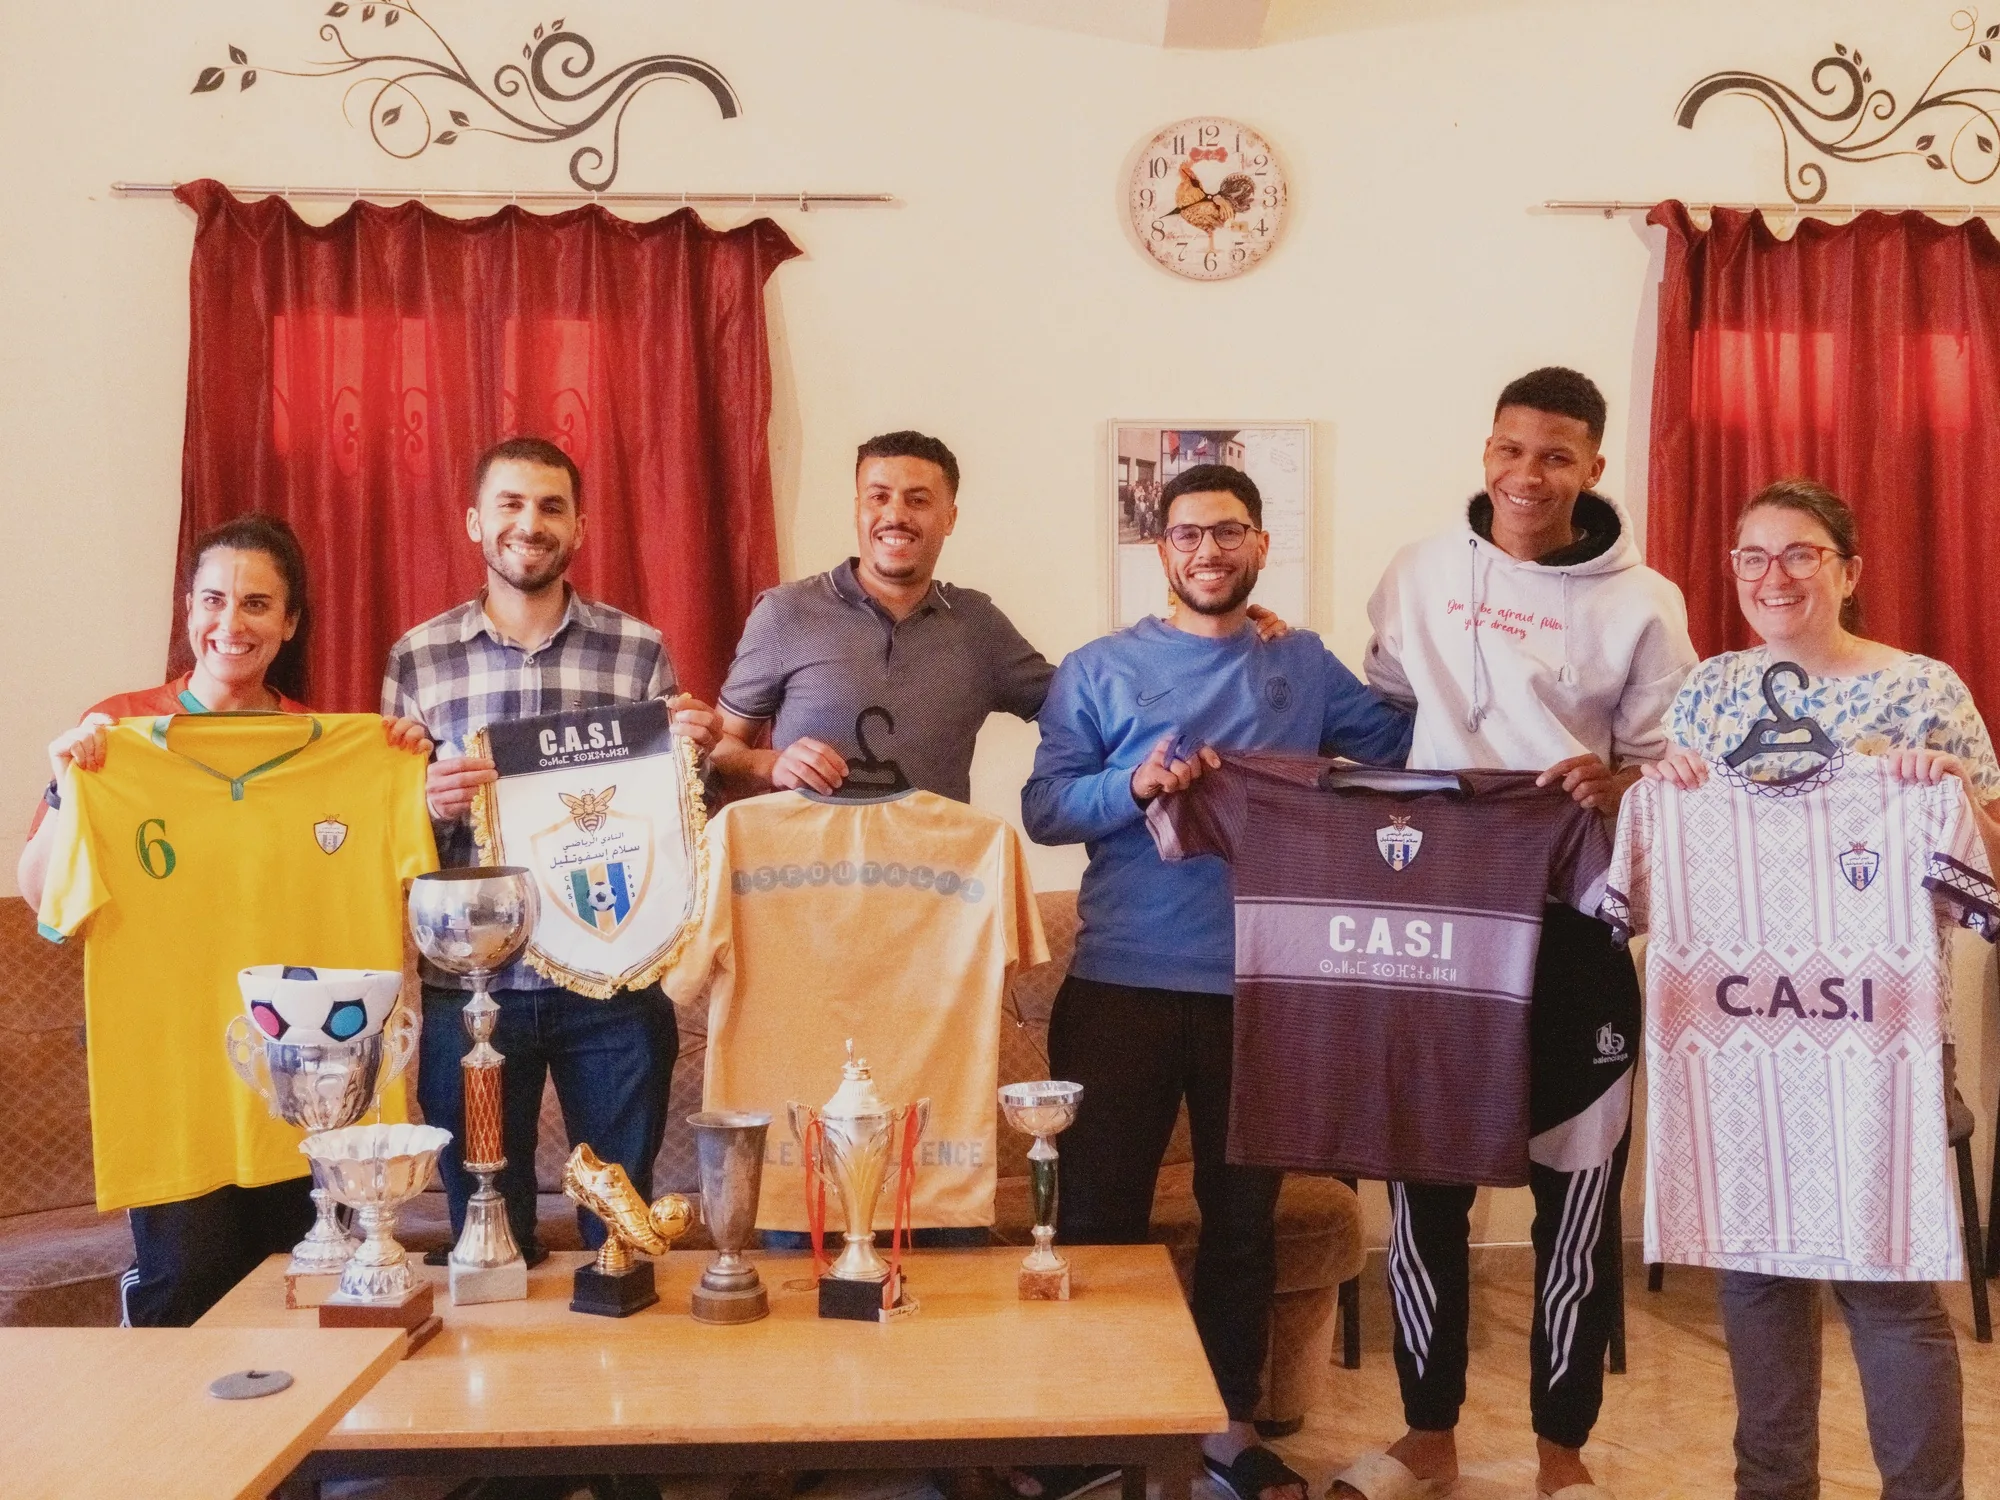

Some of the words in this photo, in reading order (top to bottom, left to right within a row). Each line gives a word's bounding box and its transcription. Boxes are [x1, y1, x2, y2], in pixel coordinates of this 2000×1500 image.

[1172, 134, 1185, 156] 11
[1198, 125, 1220, 147] 12
[1234, 133, 1241, 153] 1
[1148, 156, 1168, 179] 10
[1253, 154, 1269, 176] 2
[1139, 188, 1154, 210] 9
[1262, 185, 1278, 208] 3
[1151, 220, 1166, 242] 8
[1252, 218, 1269, 237] 4
[1175, 242, 1188, 262] 7
[1203, 252, 1218, 272] 6
[1232, 242, 1246, 262] 5
[1480, 602, 1492, 614] be
[538, 720, 622, 756] C.A.S.I
[135, 818, 176, 880] 6
[1329, 915, 1454, 960] C.A.S.I
[1715, 974, 1874, 1023] C.A.S.I
